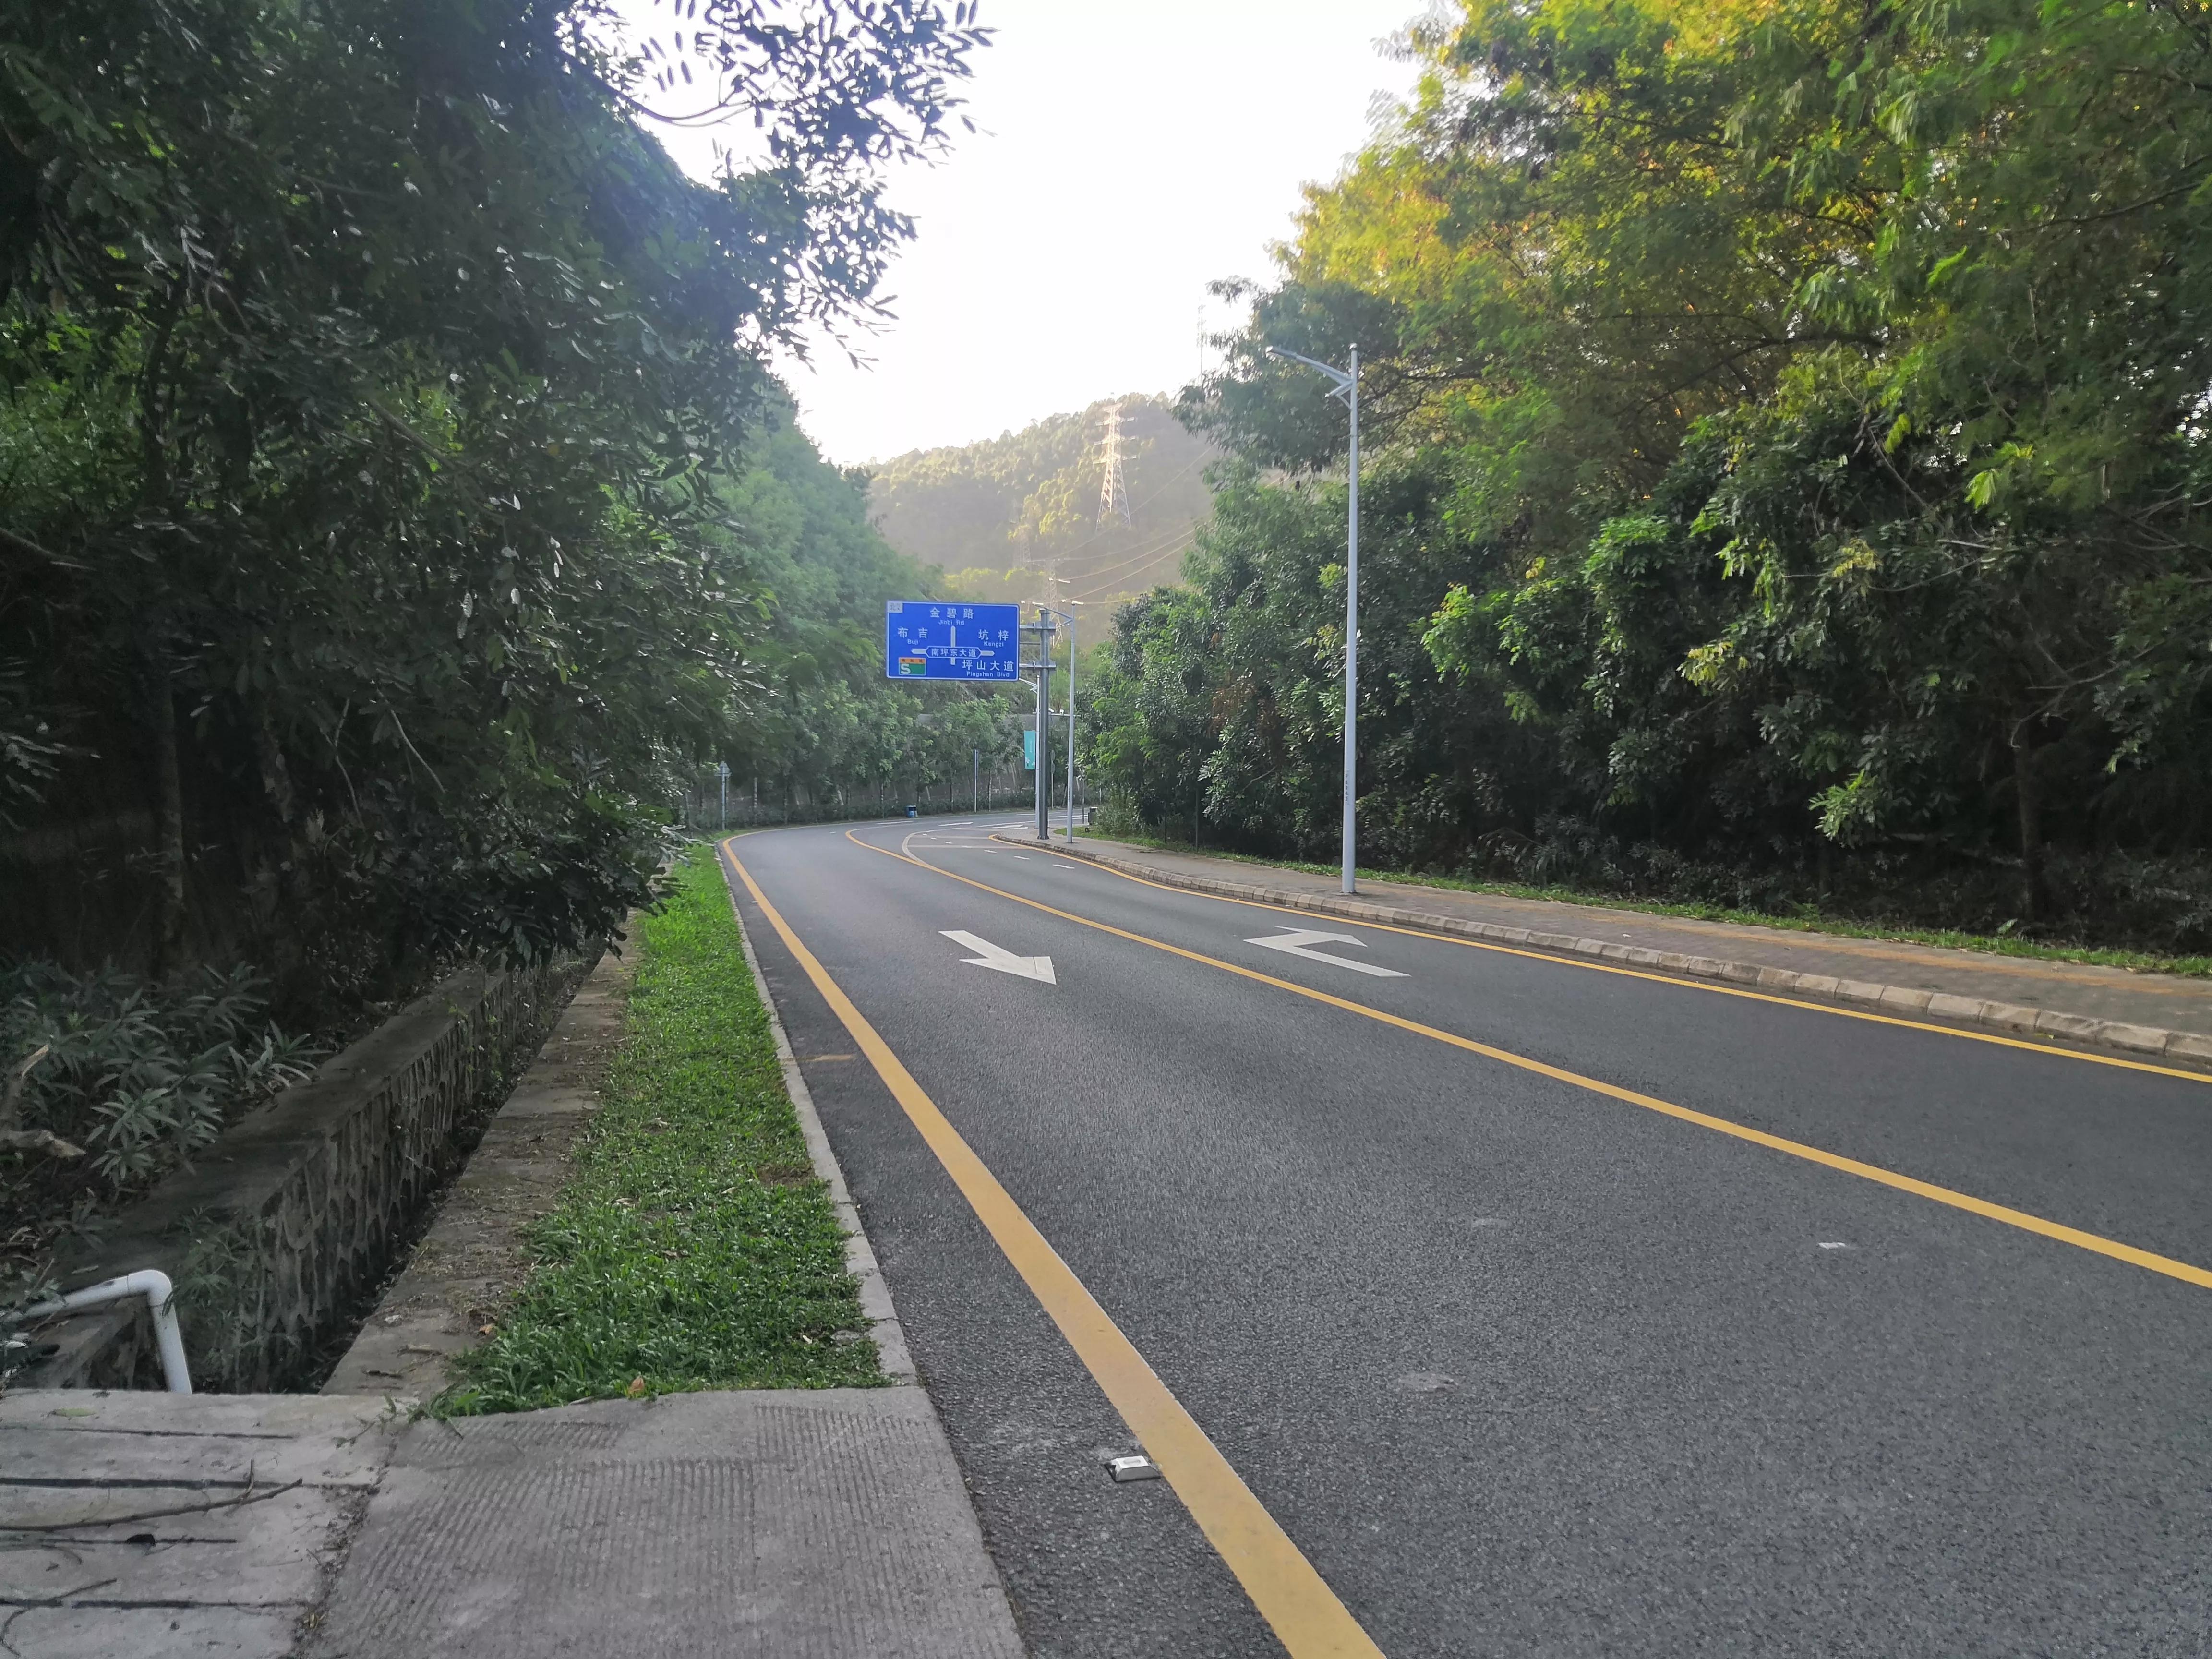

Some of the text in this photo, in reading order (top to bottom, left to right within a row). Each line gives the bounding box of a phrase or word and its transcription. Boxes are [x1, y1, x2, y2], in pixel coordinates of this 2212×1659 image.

[930, 607, 974, 619] 金碧路
[898, 627, 928, 638] 布吉
[978, 629, 1009, 641] 坑梓
[931, 648, 976, 657] 南坪东大道
[901, 663, 911, 674] S
[962, 660, 1014, 672] 坪山大道
